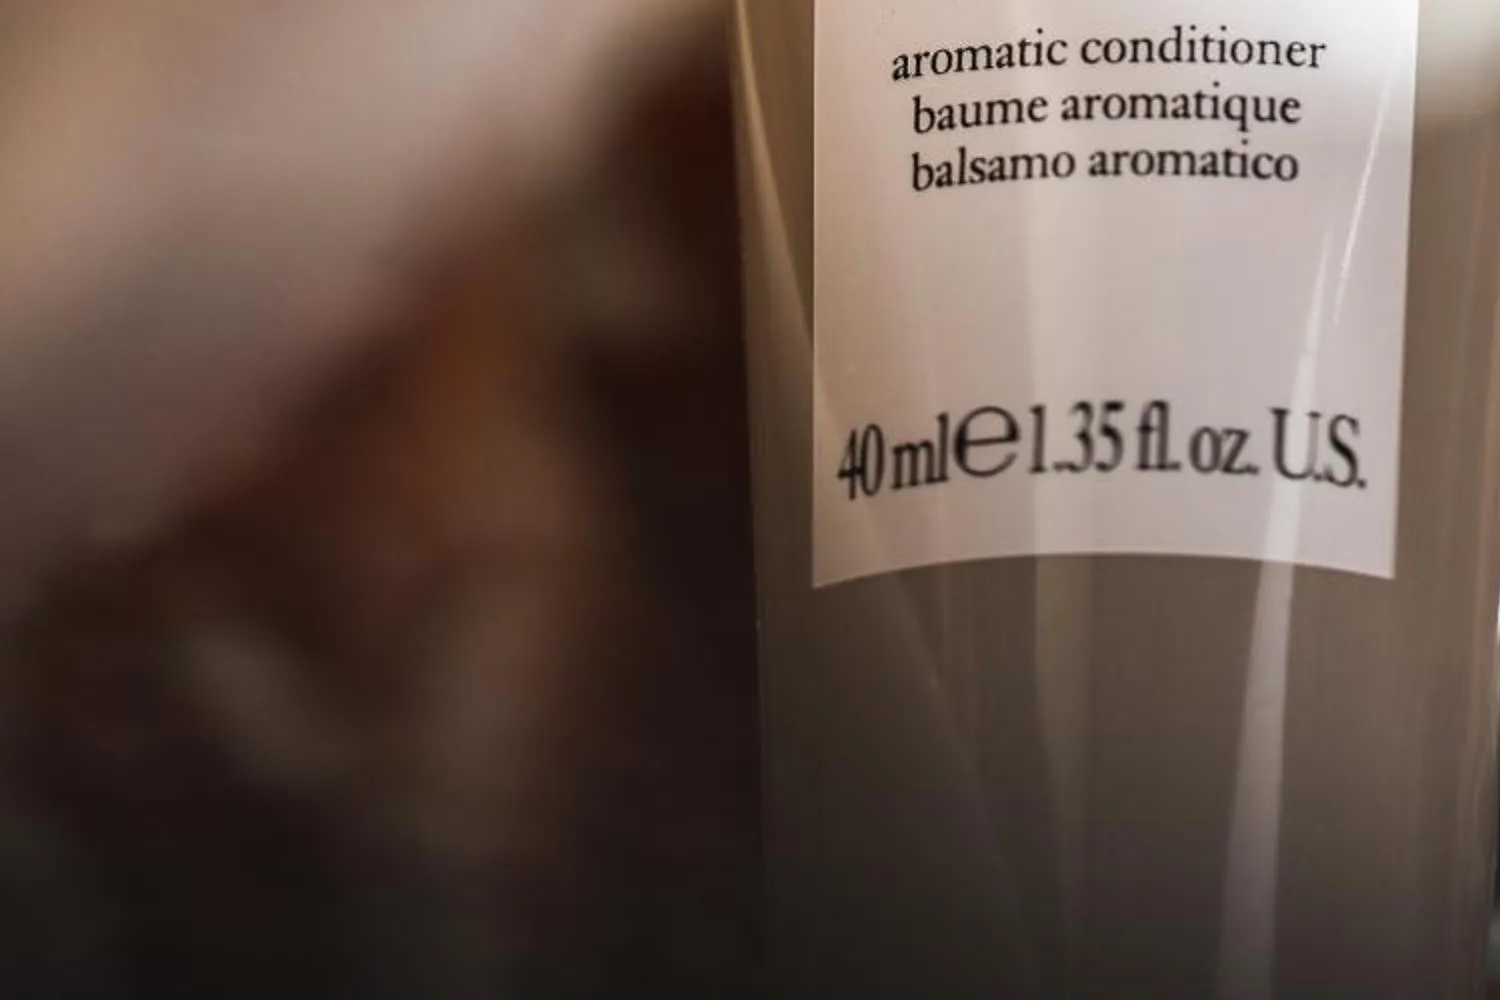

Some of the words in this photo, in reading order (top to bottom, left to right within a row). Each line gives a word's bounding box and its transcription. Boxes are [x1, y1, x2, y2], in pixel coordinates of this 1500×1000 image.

[892, 28, 1068, 81] aromatic
[1080, 25, 1327, 69] conditioner
[913, 94, 1048, 133] baume
[1061, 81, 1302, 131] aromatique
[911, 146, 1075, 191] balsamo
[1088, 138, 1300, 182] aromatico
[837, 423, 884, 501] 40
[1027, 400, 1124, 476] 1.35
[1189, 425, 1260, 476] oz.
[1270, 406, 1368, 489] U.S.
